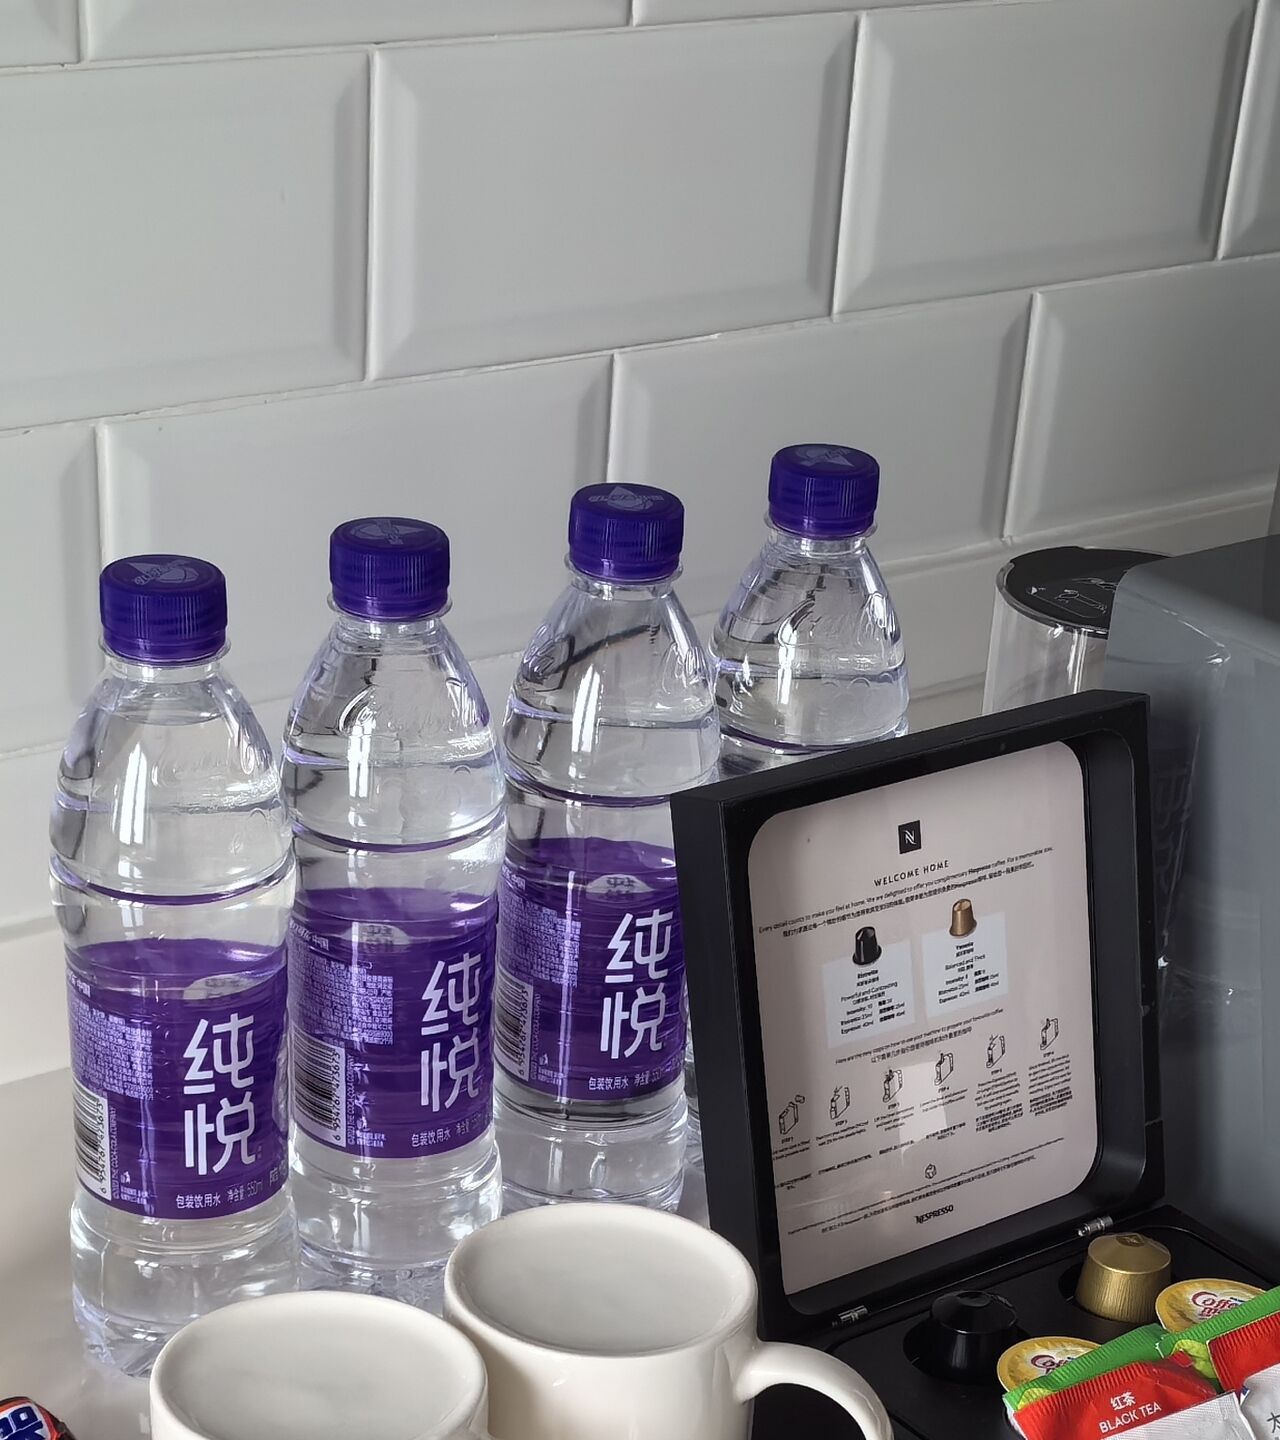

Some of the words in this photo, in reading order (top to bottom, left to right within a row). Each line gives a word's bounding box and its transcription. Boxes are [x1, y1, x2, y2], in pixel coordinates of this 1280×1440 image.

[873, 868, 920, 887] WELCOME
[923, 860, 949, 874] HOME
[600, 908, 673, 1060] 纯悦
[420, 952, 482, 1113] 纯悦
[183, 1011, 256, 1176] 纯悦
[588, 1076, 629, 1092] 包装饮用水
[411, 1127, 452, 1148] 包装饮用水
[175, 1193, 222, 1210] 包装饮用水
[915, 1204, 955, 1225] NESPRESSO
[1110, 1391, 1136, 1412] 红茶
[1099, 1411, 1140, 1434] BLACK
[1138, 1401, 1162, 1419] TEA
